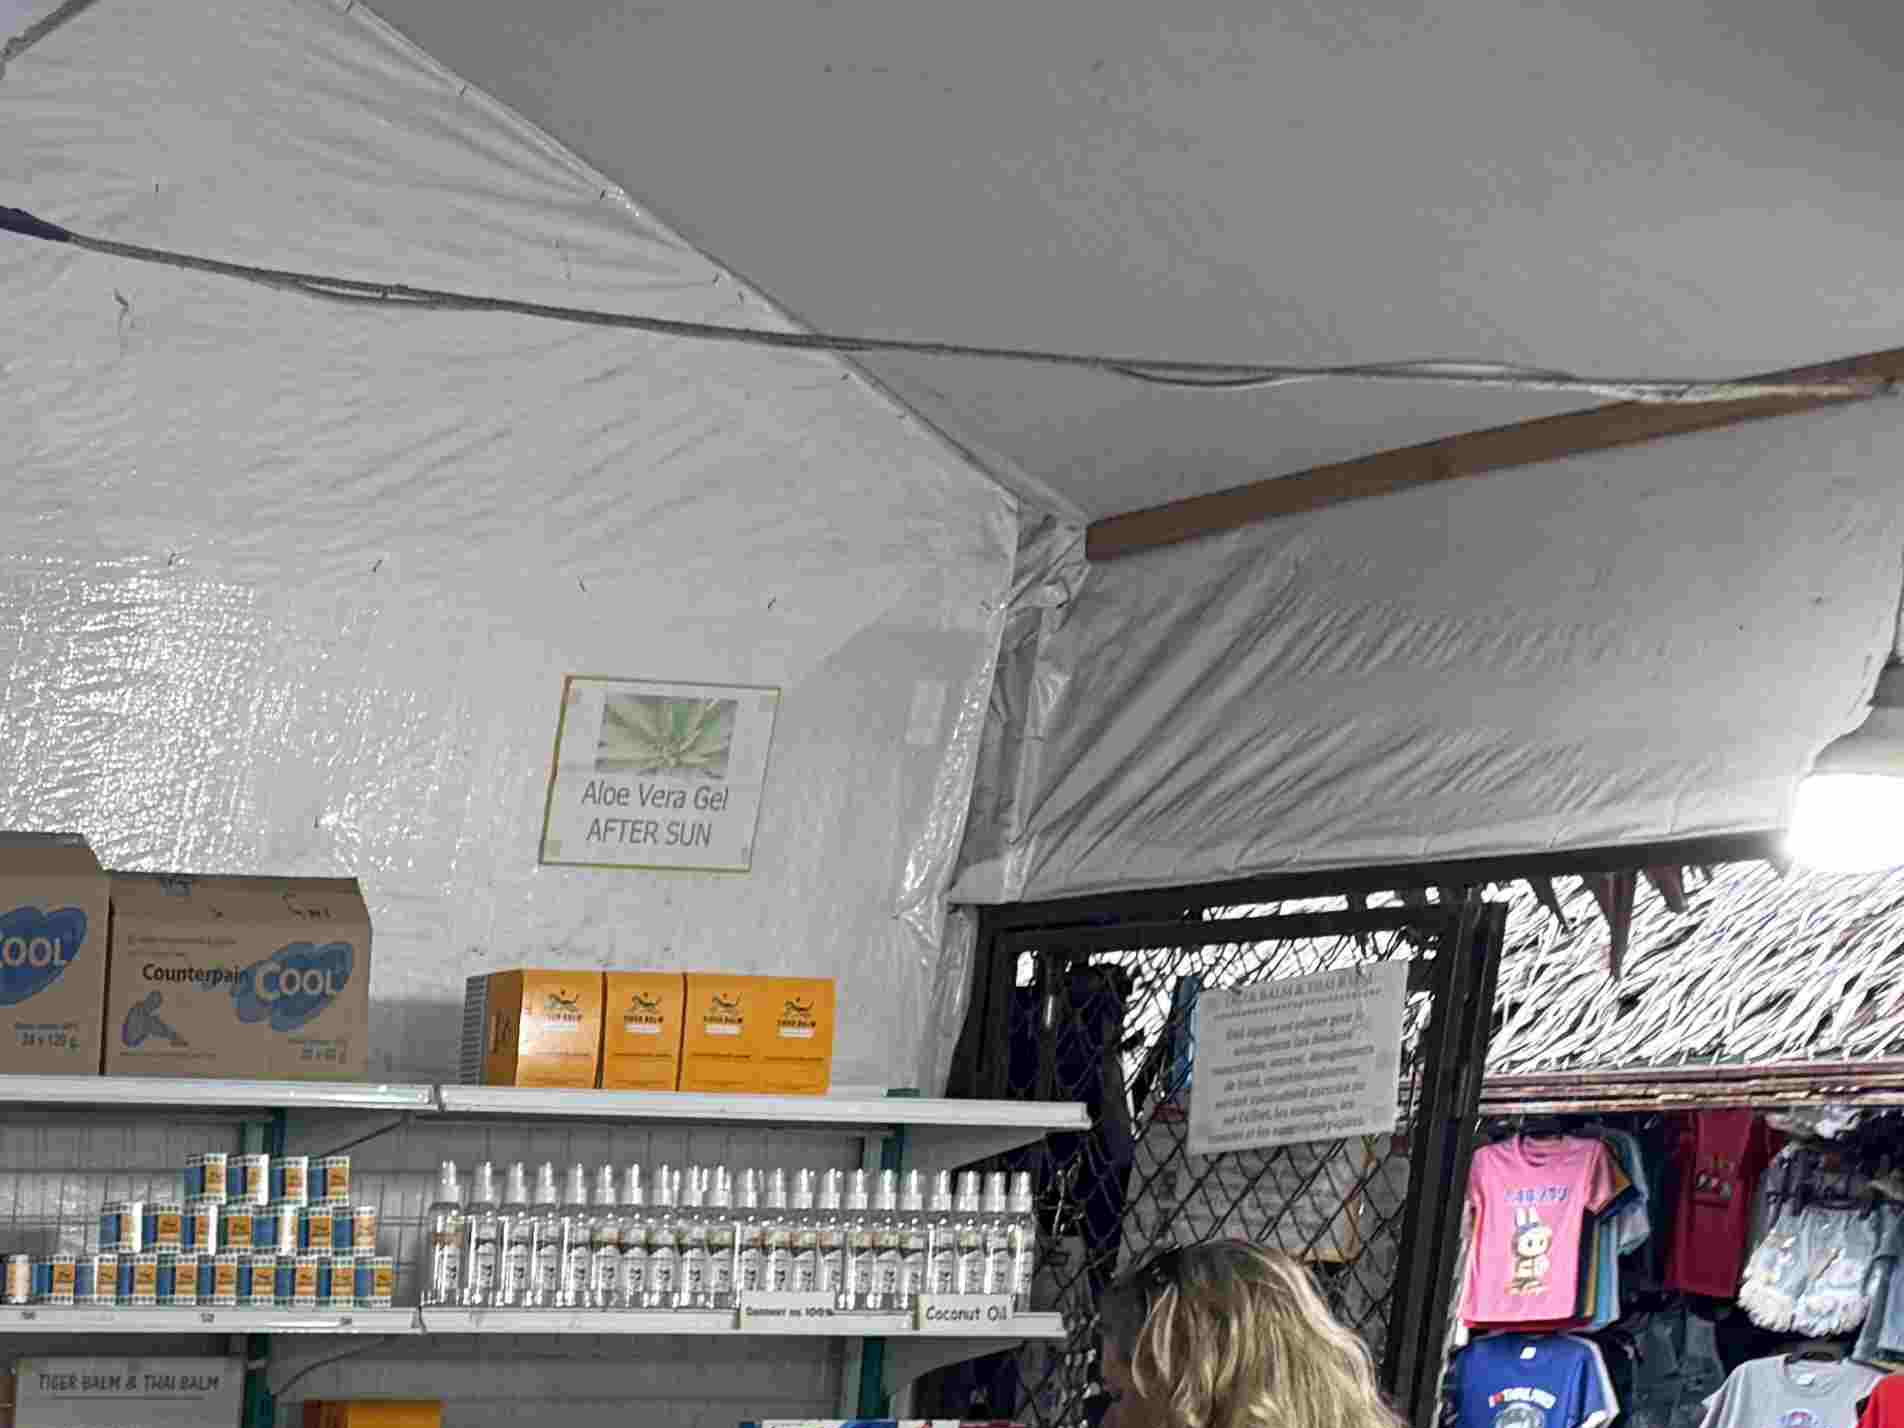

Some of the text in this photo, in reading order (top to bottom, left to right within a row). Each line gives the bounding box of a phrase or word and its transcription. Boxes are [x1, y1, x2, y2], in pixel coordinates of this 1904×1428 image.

[580, 779, 728, 811] Aloe Vera Gel
[586, 820, 711, 847] AFTER SUN
[142, 963, 337, 996] Counterpain COOL
[925, 1305, 1007, 1322] Coconut Oil
[39, 1374, 76, 1392] TIGER
